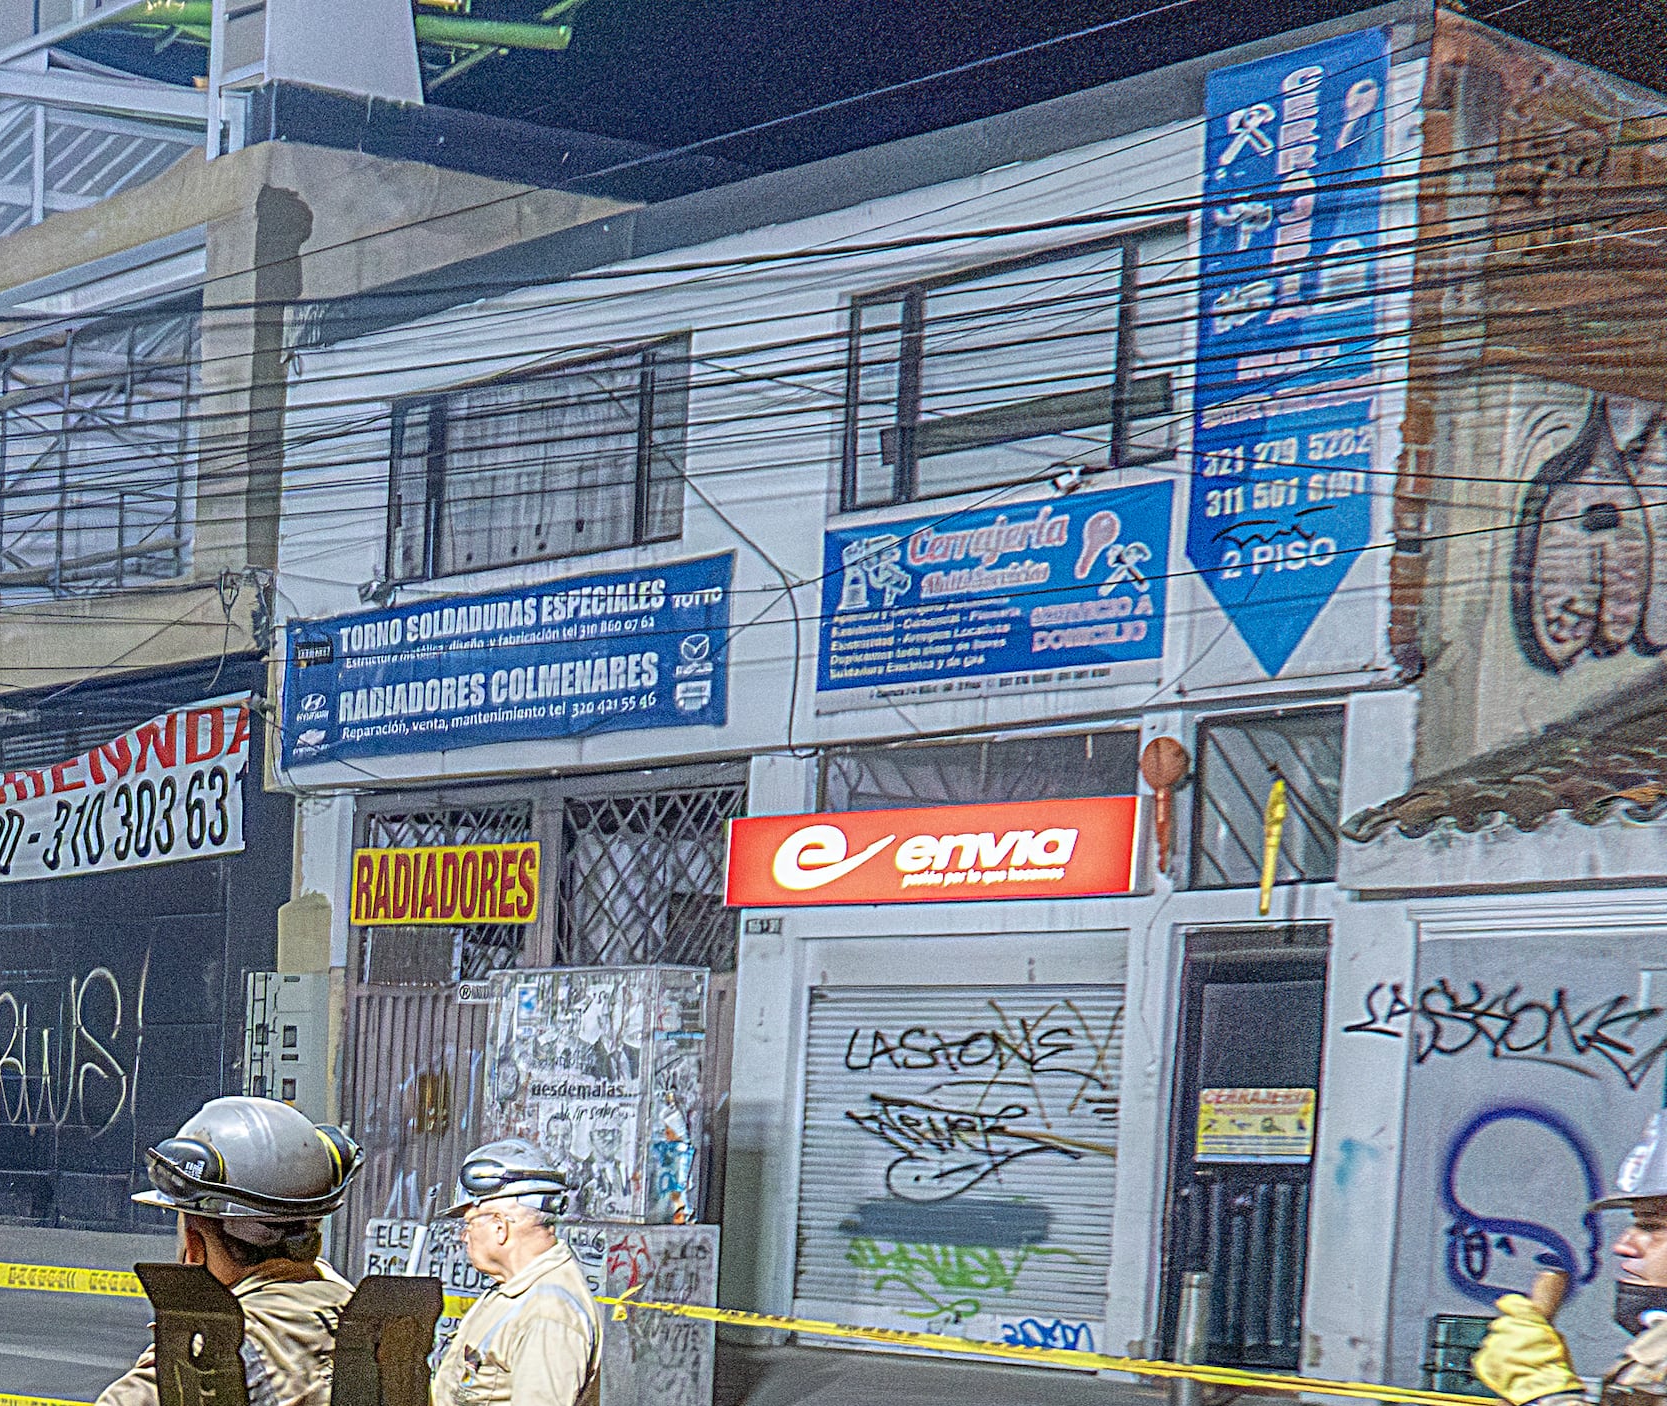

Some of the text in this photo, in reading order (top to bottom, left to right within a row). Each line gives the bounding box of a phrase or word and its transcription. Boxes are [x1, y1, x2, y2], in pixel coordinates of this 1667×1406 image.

[1205, 486, 1244, 517] 311
[1220, 537, 1337, 579] 2 PISO
[339, 579, 666, 654] TORNO SOLDADURAS ESPECIALES
[338, 651, 659, 724] RADIADORES COLMENARES
[412, 714, 449, 733] venta,
[451, 703, 545, 728] mantenimiento
[549, 702, 566, 716] tel
[571, 701, 594, 718] 320
[620, 695, 637, 711] 55
[43, 790, 106, 871] 310
[114, 775, 178, 862] 303
[354, 848, 537, 921] RADIADORES
